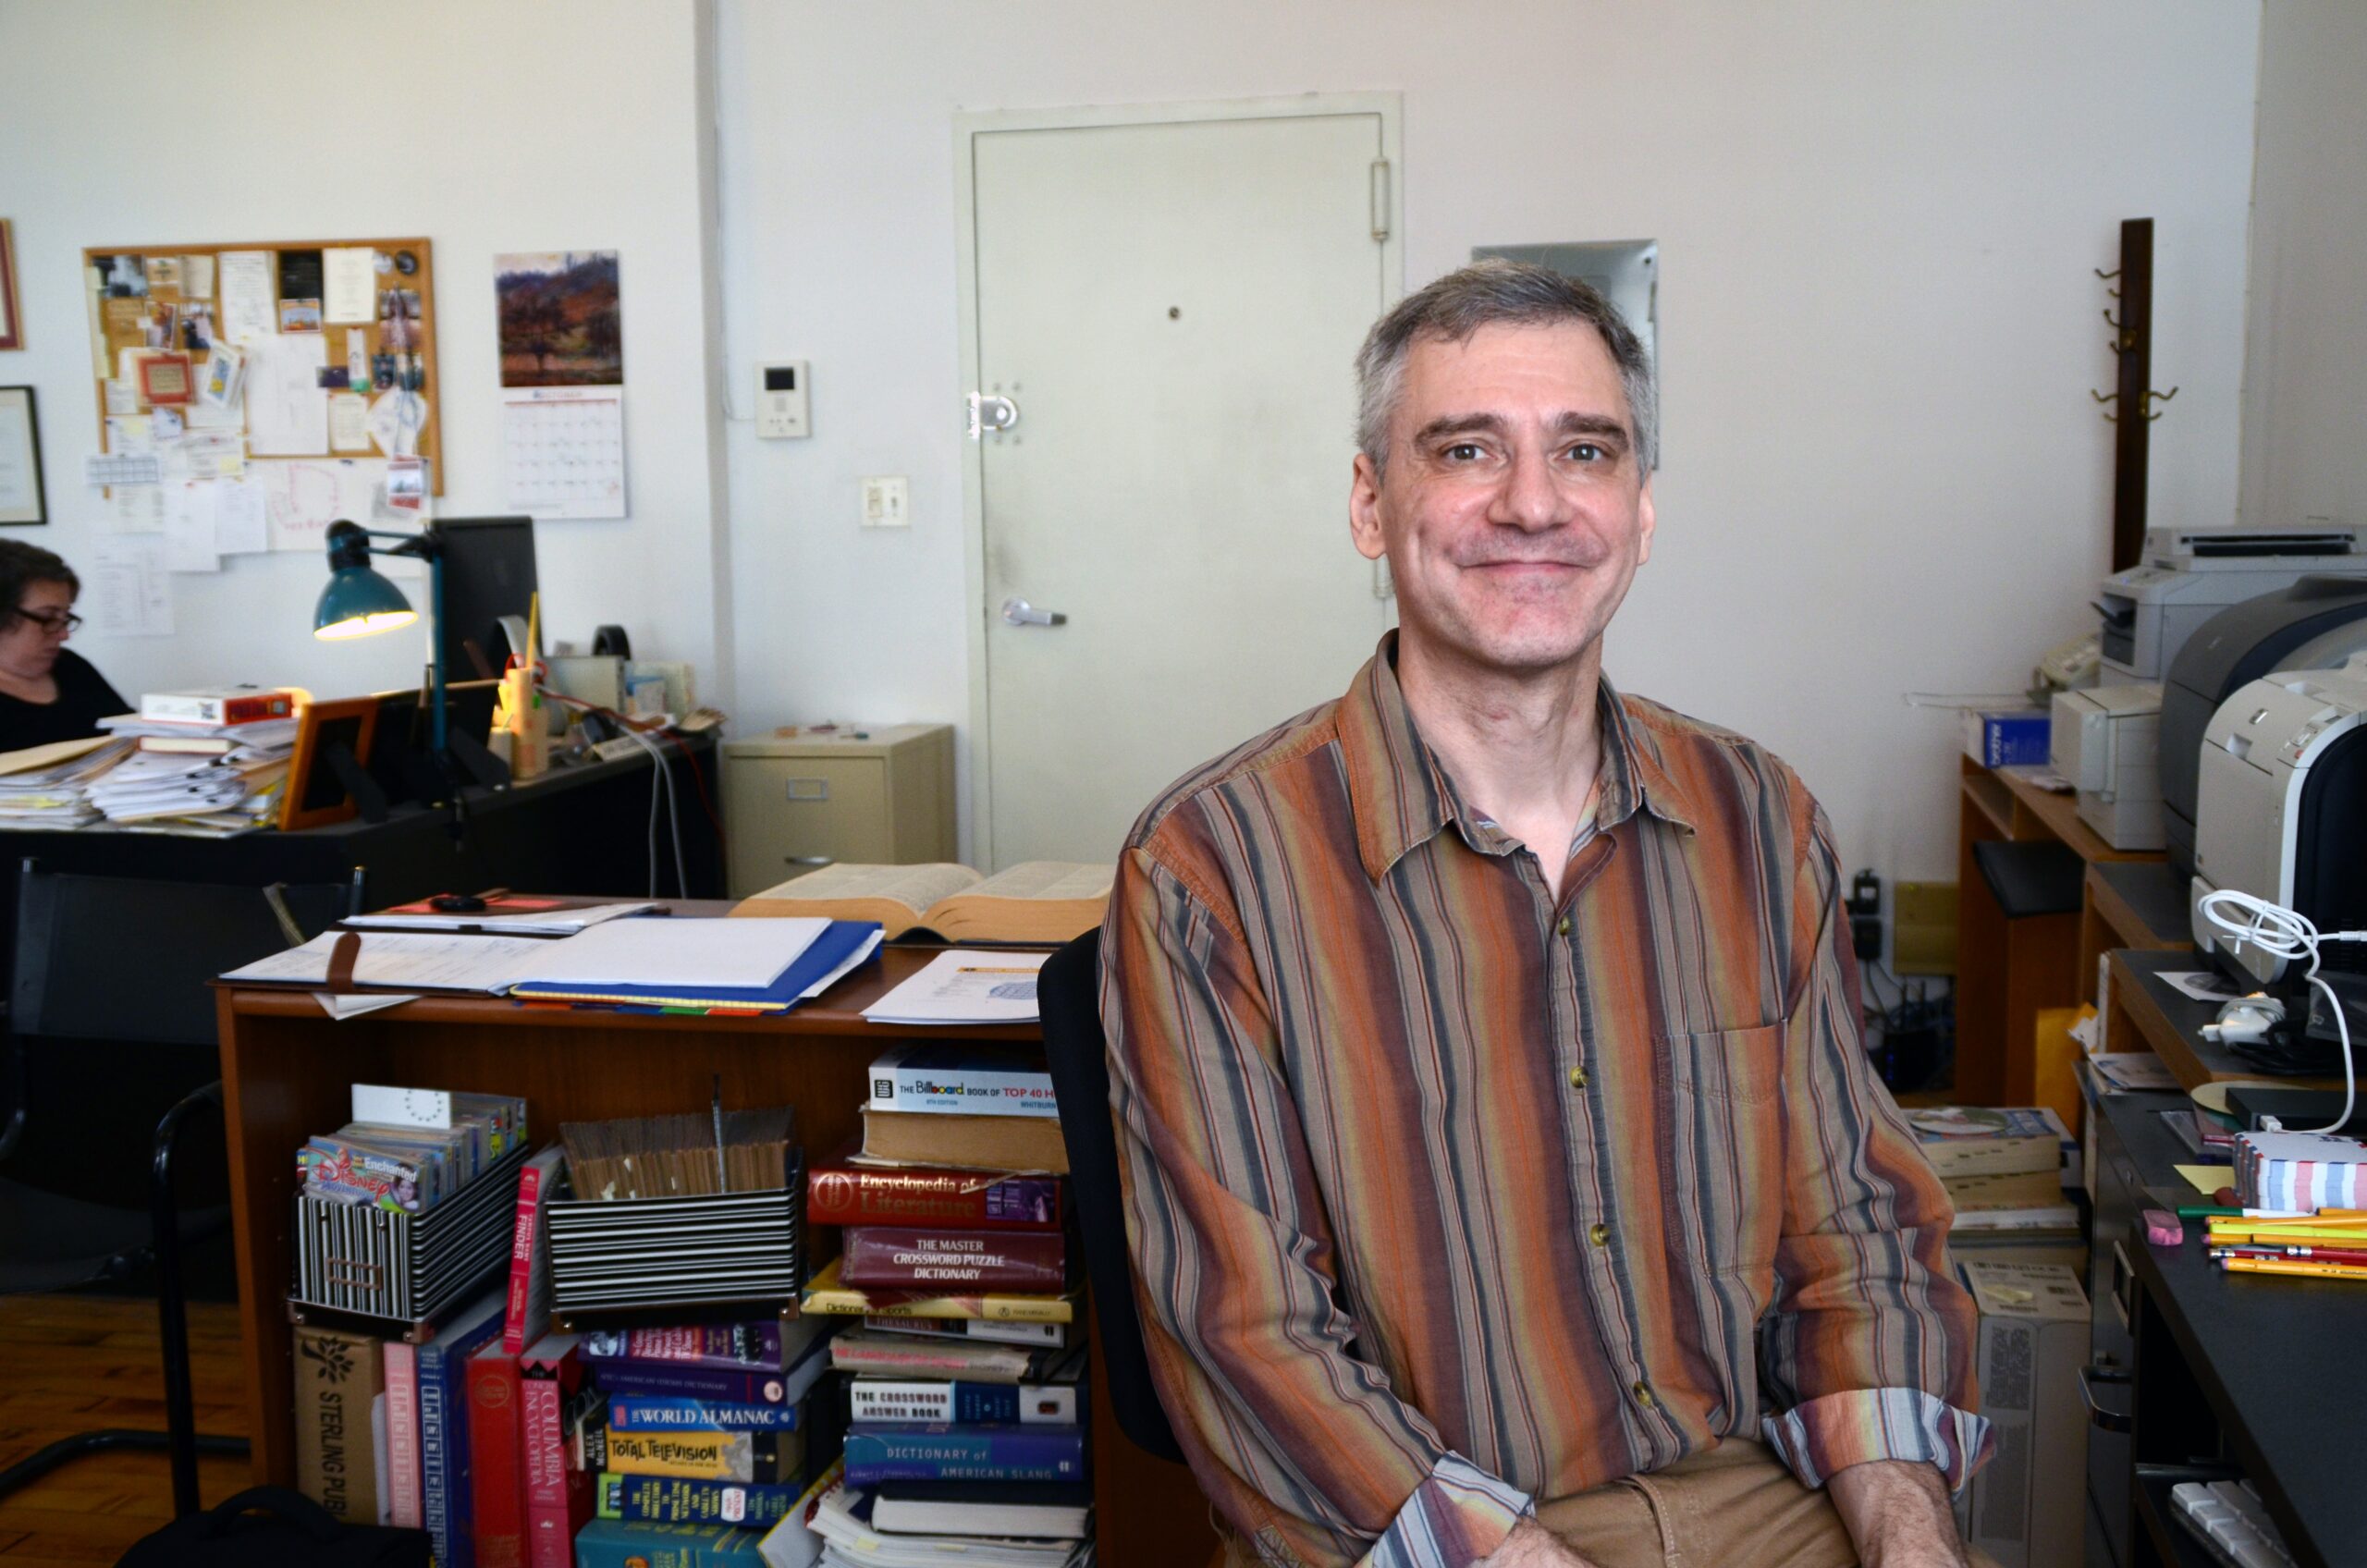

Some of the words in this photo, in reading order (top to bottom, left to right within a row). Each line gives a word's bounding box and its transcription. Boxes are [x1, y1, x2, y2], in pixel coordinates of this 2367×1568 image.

[1989, 723, 2002, 766] brother
[900, 1085, 914, 1094] THE
[915, 1081, 964, 1095] Billboard
[967, 1088, 987, 1096] BOOK
[1003, 1089, 1026, 1097] TOP
[1030, 1089, 1042, 1098] 40
[1045, 1090, 1055, 1099] H
[363, 1157, 418, 1182] Enchanted
[860, 1174, 955, 1194] Encyclopedia
[860, 1193, 976, 1217] Literature
[514, 1214, 527, 1260] FINDER
[916, 1239, 938, 1251] THE
[938, 1240, 984, 1252] MASTER
[893, 1254, 961, 1266] CROSSWORD
[963, 1255, 1005, 1268] PUZZLE
[914, 1268, 981, 1280] DICTIONARY
[683, 1379, 729, 1391] DICTIONARY
[854, 1391, 875, 1403] THE
[879, 1392, 948, 1403] CROSSWORD
[640, 1408, 696, 1424] WORLD
[700, 1409, 775, 1425] ALMANAC
[862, 1407, 906, 1417] ANSWER
[912, 1408, 940, 1418] BOOK
[319, 1390, 345, 1474] STERLING
[524, 1390, 542, 1487] ENCYCLOPEDIA
[540, 1390, 561, 1487] COLUMBIA
[585, 1434, 595, 1459] ALEX
[610, 1439, 645, 1461] TOTAL
[647, 1439, 717, 1462] TELEVISION
[887, 1448, 968, 1461] DICTIONARY
[973, 1450, 987, 1462] of
[940, 1466, 1004, 1480] AMERICAN
[1012, 1467, 1052, 1480] SLANG
[641, 1481, 651, 1517] COMPLETE
[651, 1481, 661, 1519] DIRECTORY
[681, 1483, 691, 1519] NETWORK
